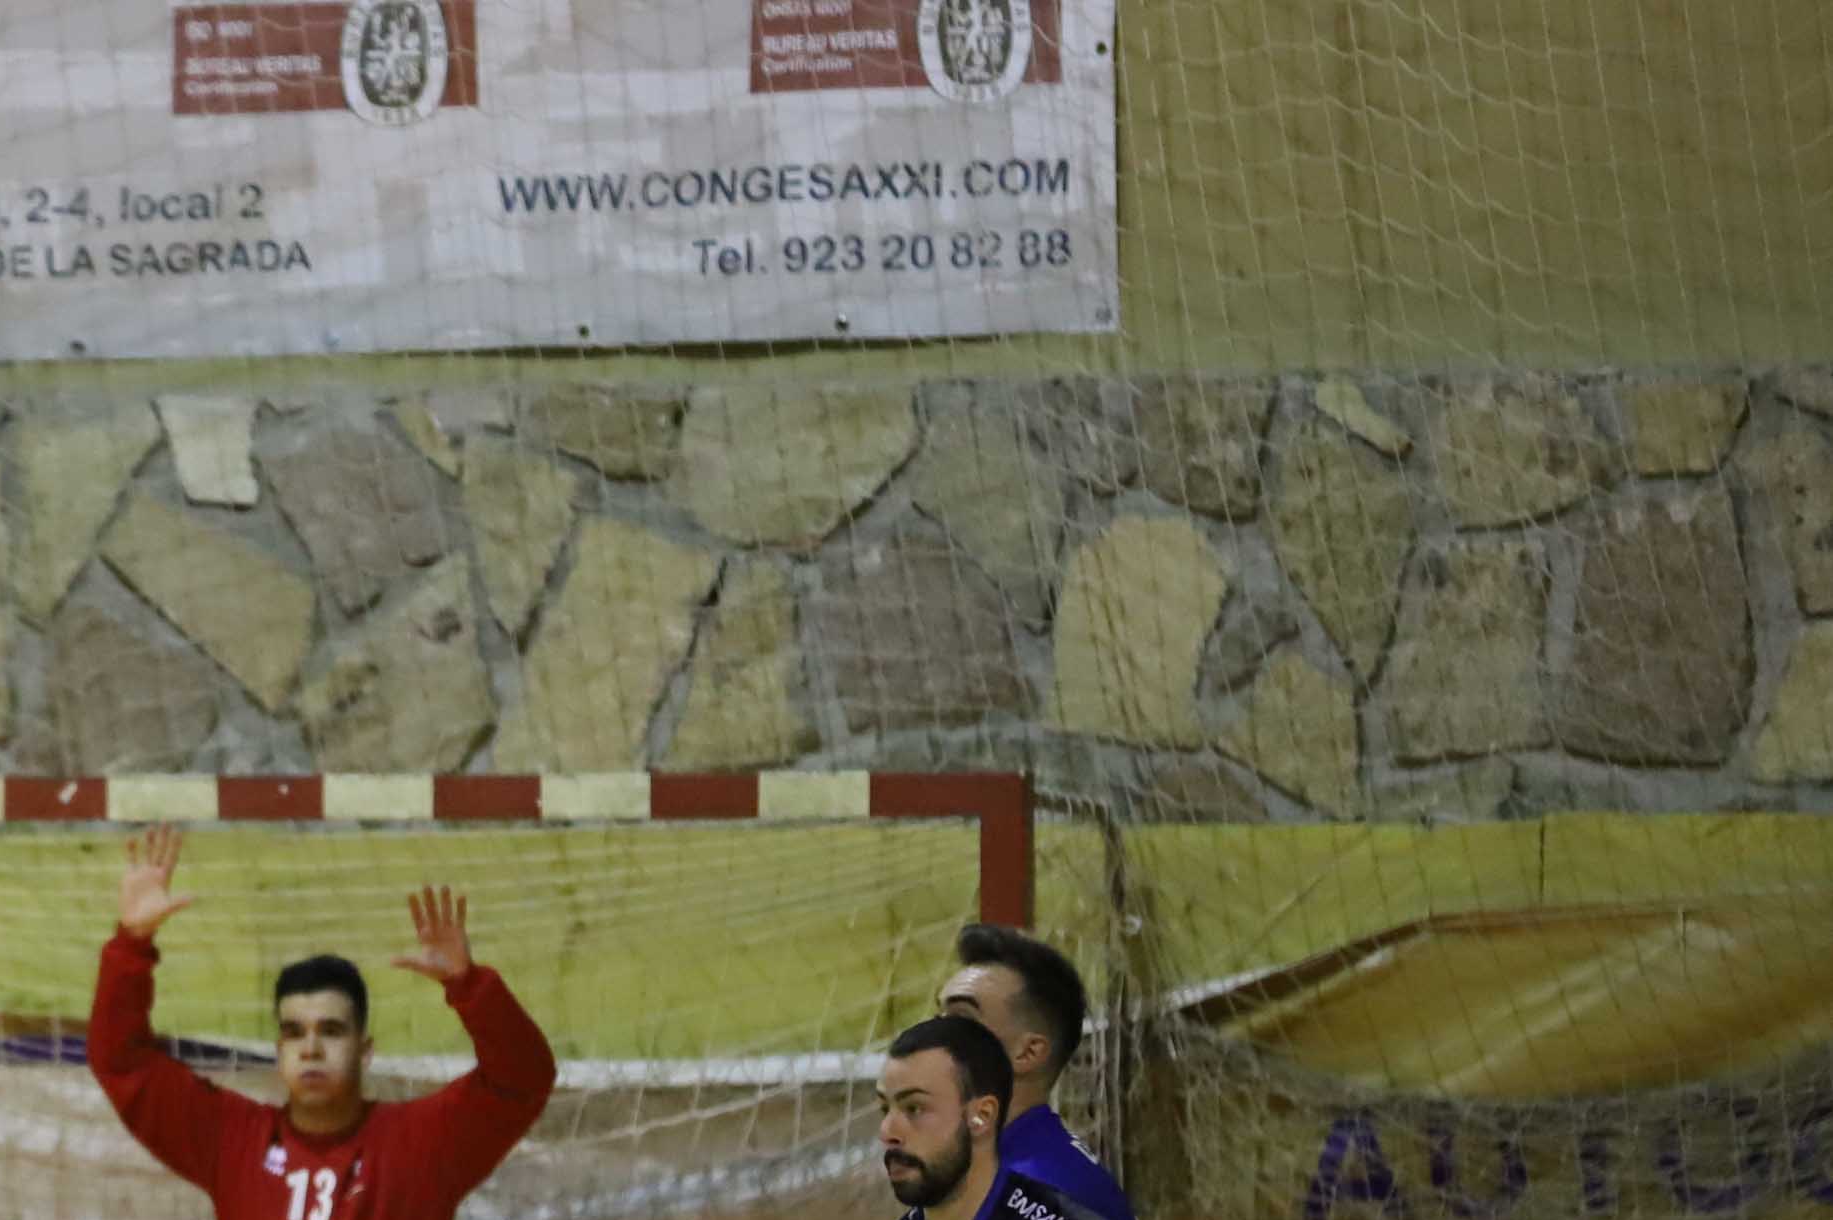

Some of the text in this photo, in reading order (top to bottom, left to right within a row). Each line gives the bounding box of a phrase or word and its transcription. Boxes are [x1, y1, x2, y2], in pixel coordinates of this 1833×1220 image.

[827, 29, 898, 51] VERITAS
[255, 54, 323, 74] VERITAS
[26, 187, 104, 227] 2-4,
[120, 182, 224, 222] local
[240, 183, 265, 219] 2
[499, 157, 1070, 213] WWW.CONGESAXXI.COM
[48, 241, 96, 277] LA
[110, 238, 313, 276] SAGRADA
[692, 229, 1072, 275] Tel. 923 20 82 88
